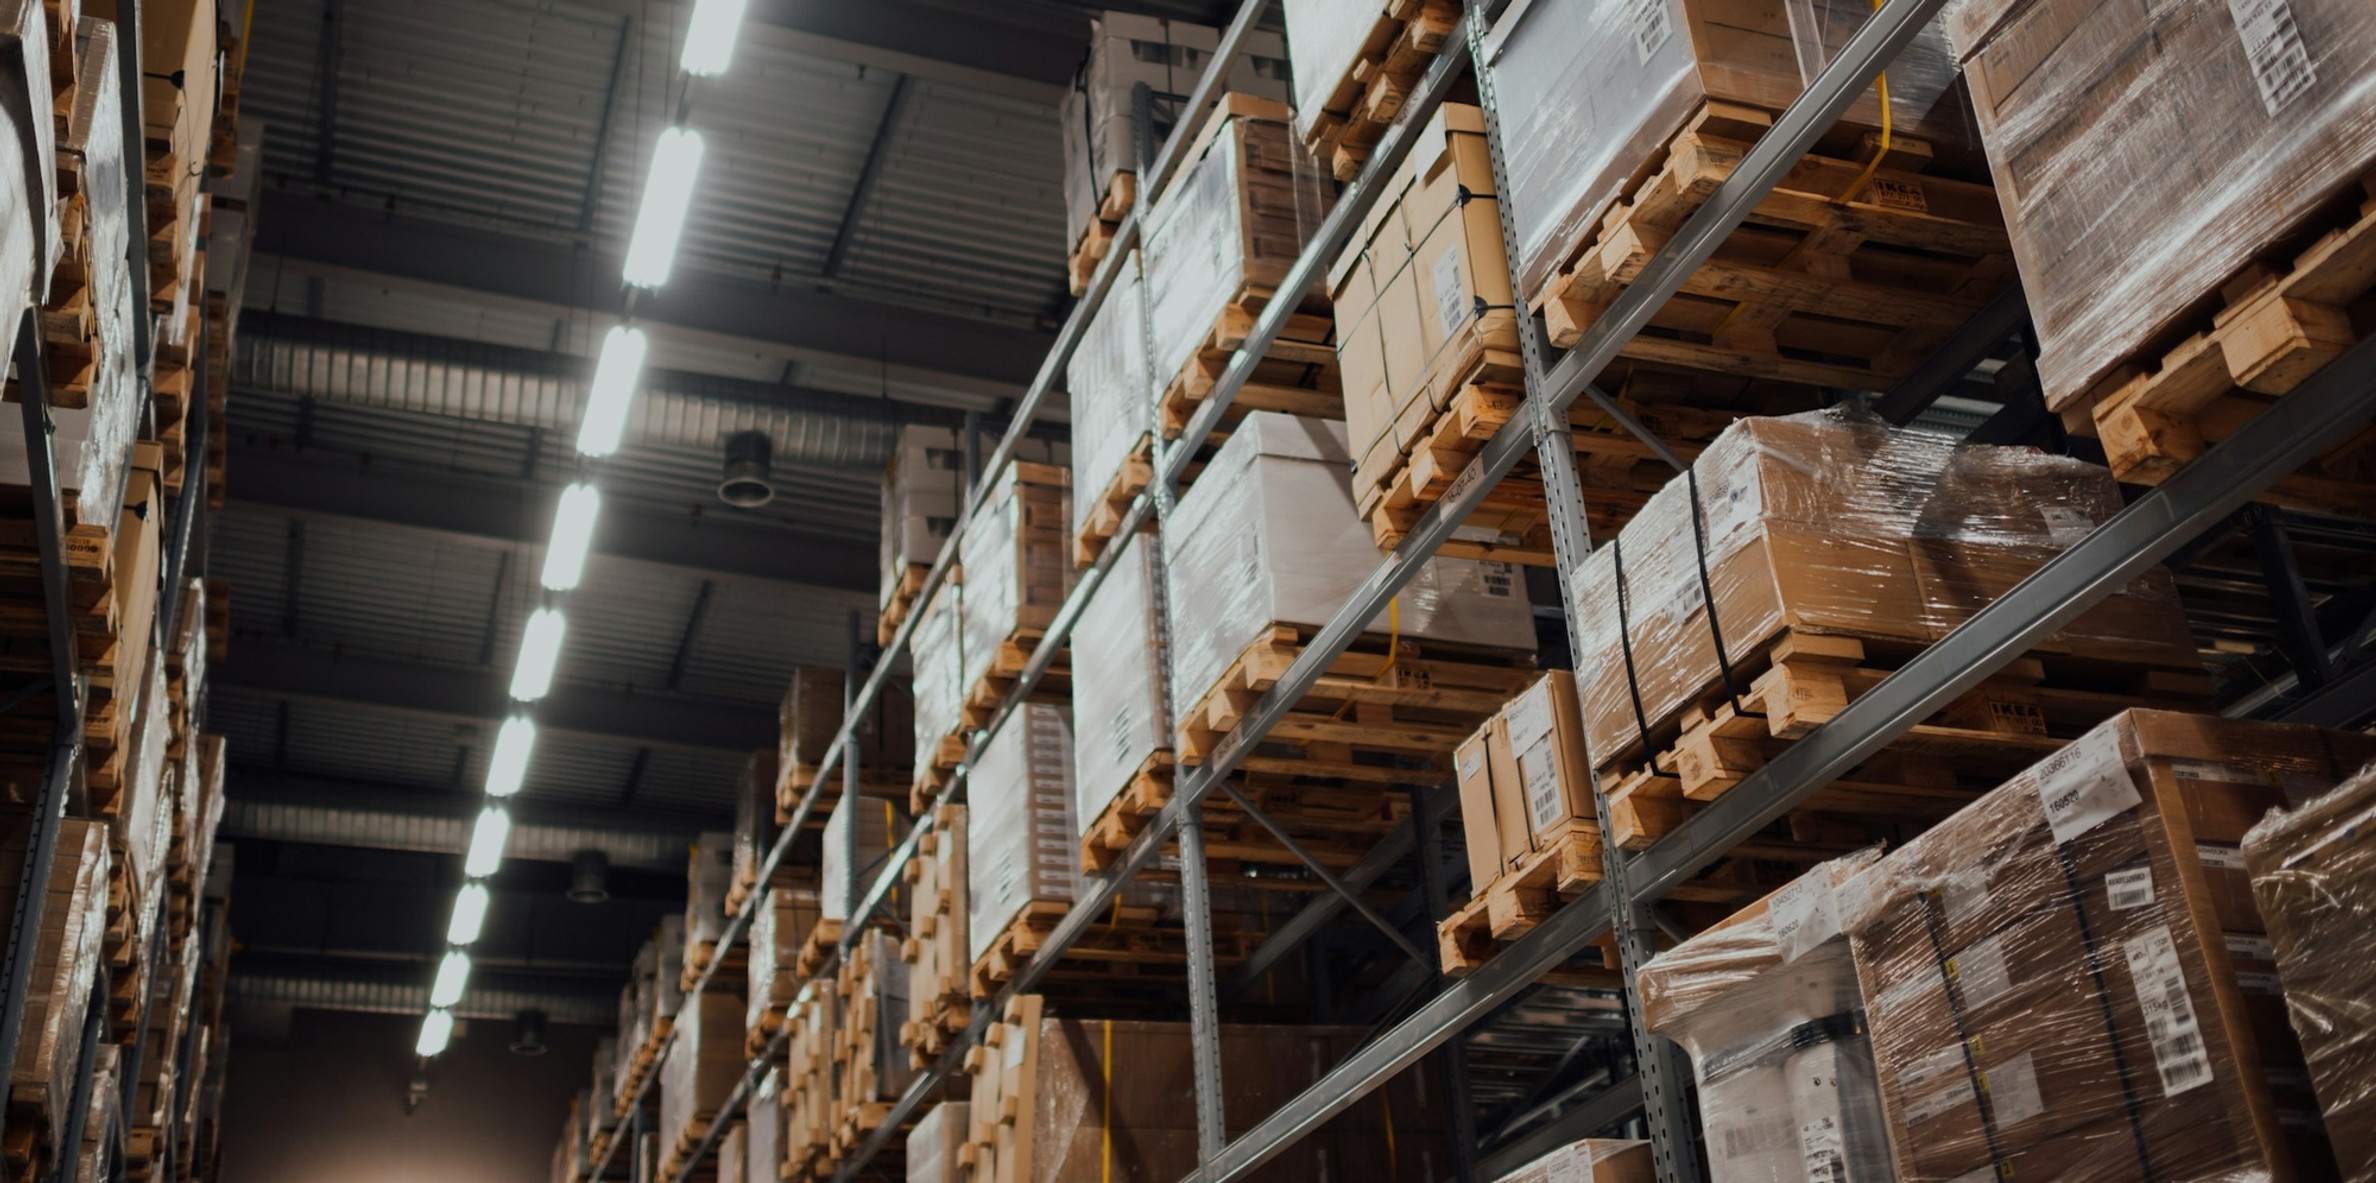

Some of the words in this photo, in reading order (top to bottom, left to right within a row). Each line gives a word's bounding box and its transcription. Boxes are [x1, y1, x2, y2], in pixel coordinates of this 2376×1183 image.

[1992, 703, 2040, 717] IKEA
[2039, 747, 2082, 780] 20366116
[2049, 789, 2080, 814] 160520
[2144, 1000, 2169, 1016] 315kg
